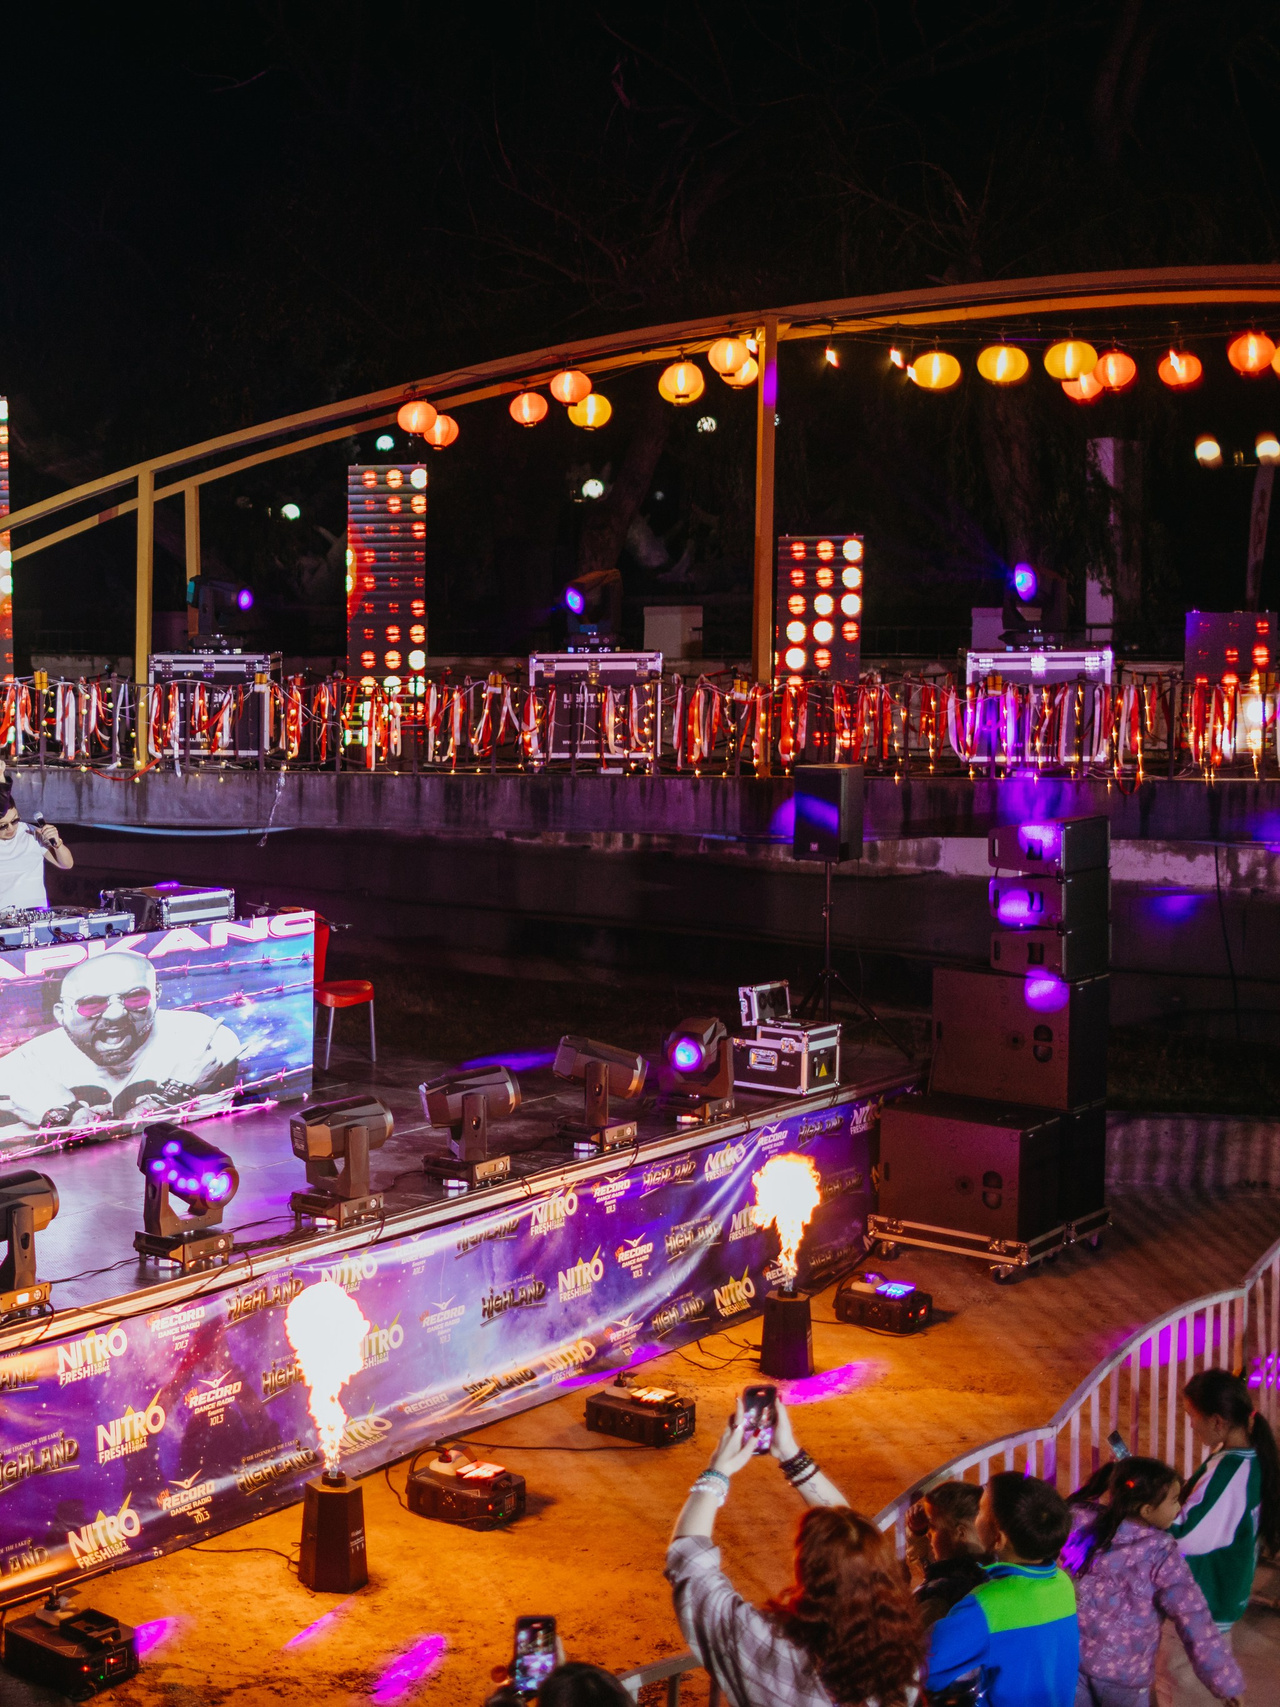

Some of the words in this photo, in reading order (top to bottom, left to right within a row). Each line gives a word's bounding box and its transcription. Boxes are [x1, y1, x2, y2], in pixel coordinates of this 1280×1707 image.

[705, 1143, 746, 1172] NITRO
[593, 1179, 631, 1198] RECORD
[531, 1192, 578, 1226] NITRO
[618, 1242, 653, 1263] RECORD
[558, 1258, 604, 1294] NITRO
[226, 1279, 303, 1321] HIGHLAND
[482, 1281, 546, 1319] HIGHLAND
[713, 1277, 755, 1310] NITRO
[151, 1306, 205, 1333] RECORD
[422, 1305, 465, 1328] RECORD
[57, 1328, 128, 1372] NITRO
[360, 1324, 404, 1359] ITRO
[60, 1365, 94, 1385] FRESH!
[189, 1381, 242, 1409] RECORD
[195, 1402, 217, 1414] DANCE
[97, 1405, 165, 1451] NITRO
[99, 1441, 132, 1464] FRESH!
[163, 1481, 215, 1511] RECORD
[170, 1503, 192, 1517] DANCE
[193, 1495, 212, 1508] RADIO
[68, 1509, 140, 1559] NITRO
[76, 1547, 115, 1569] FRESH!
